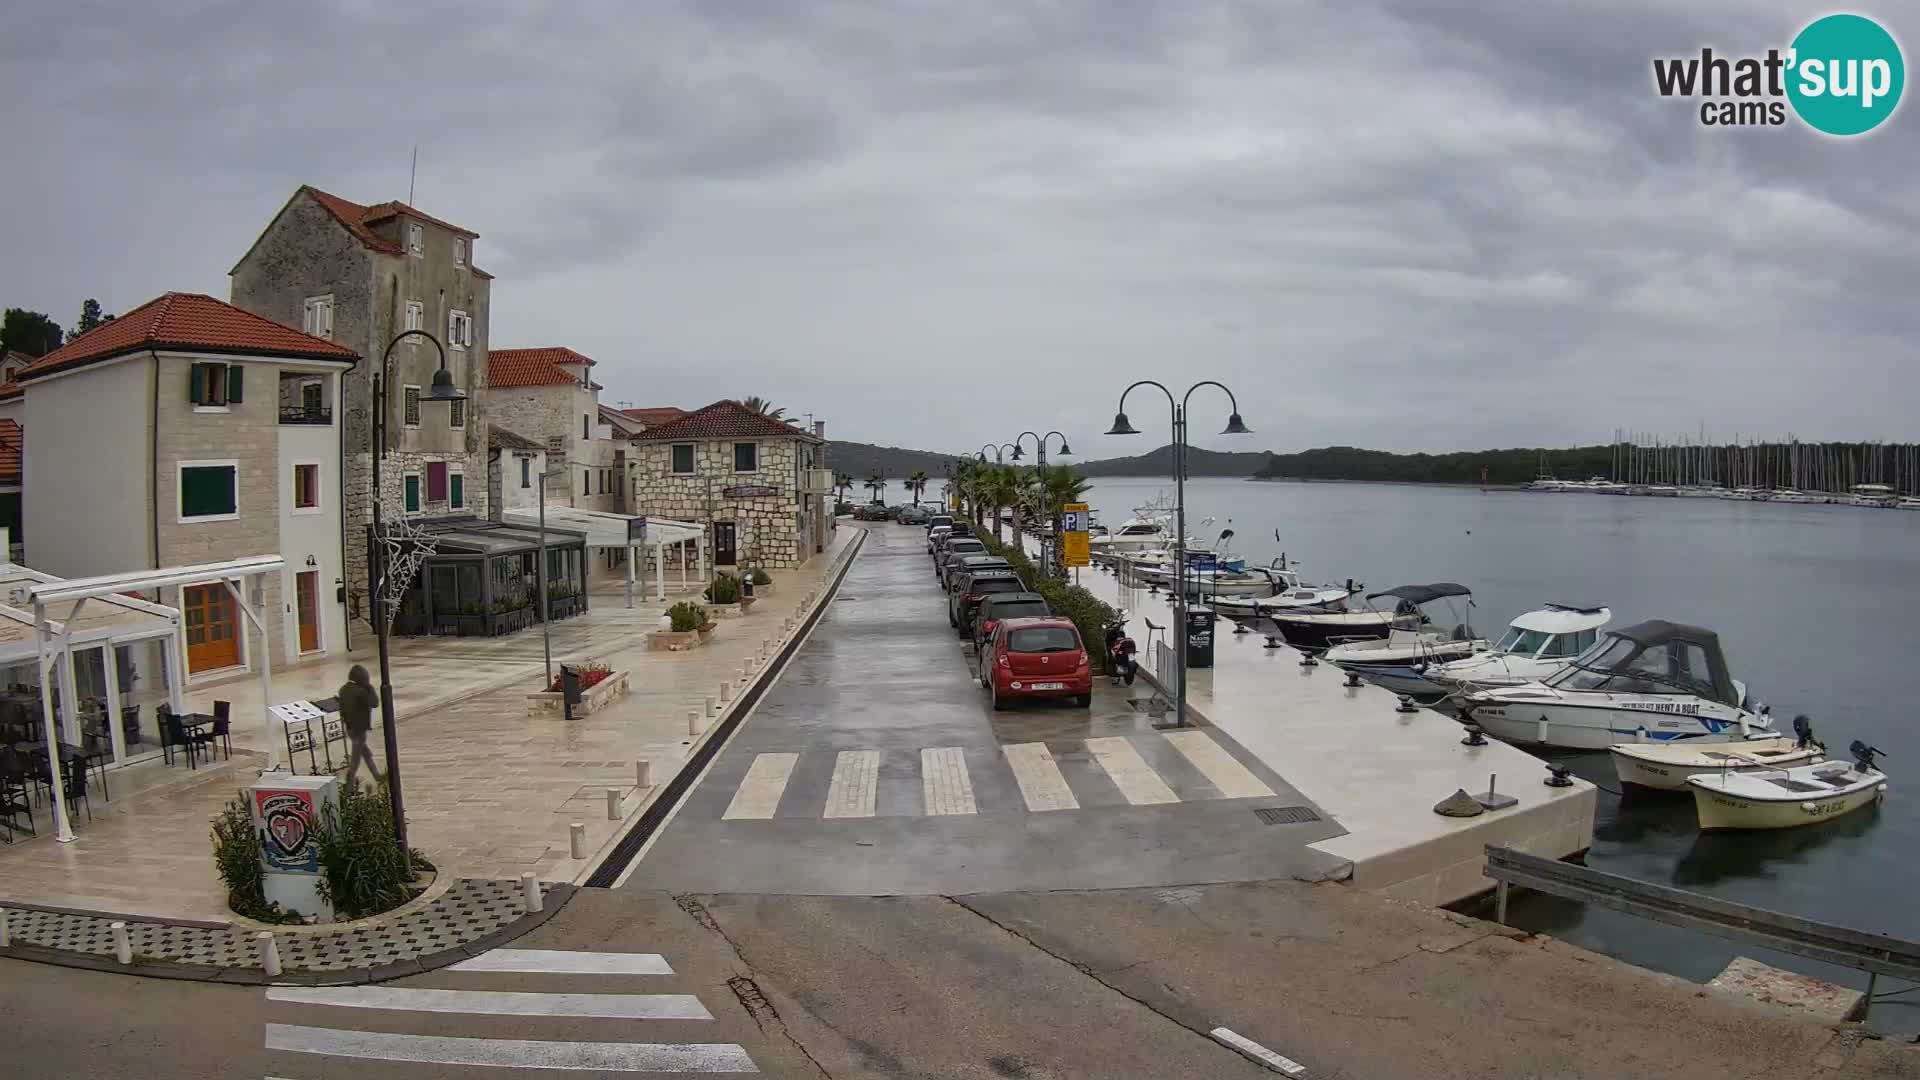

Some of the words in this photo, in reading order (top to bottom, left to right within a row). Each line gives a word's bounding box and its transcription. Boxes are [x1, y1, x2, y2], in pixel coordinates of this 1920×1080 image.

[1656, 704, 1674, 712] RENT
[1675, 703, 1681, 713] A
[1682, 704, 1699, 714] BOAT
